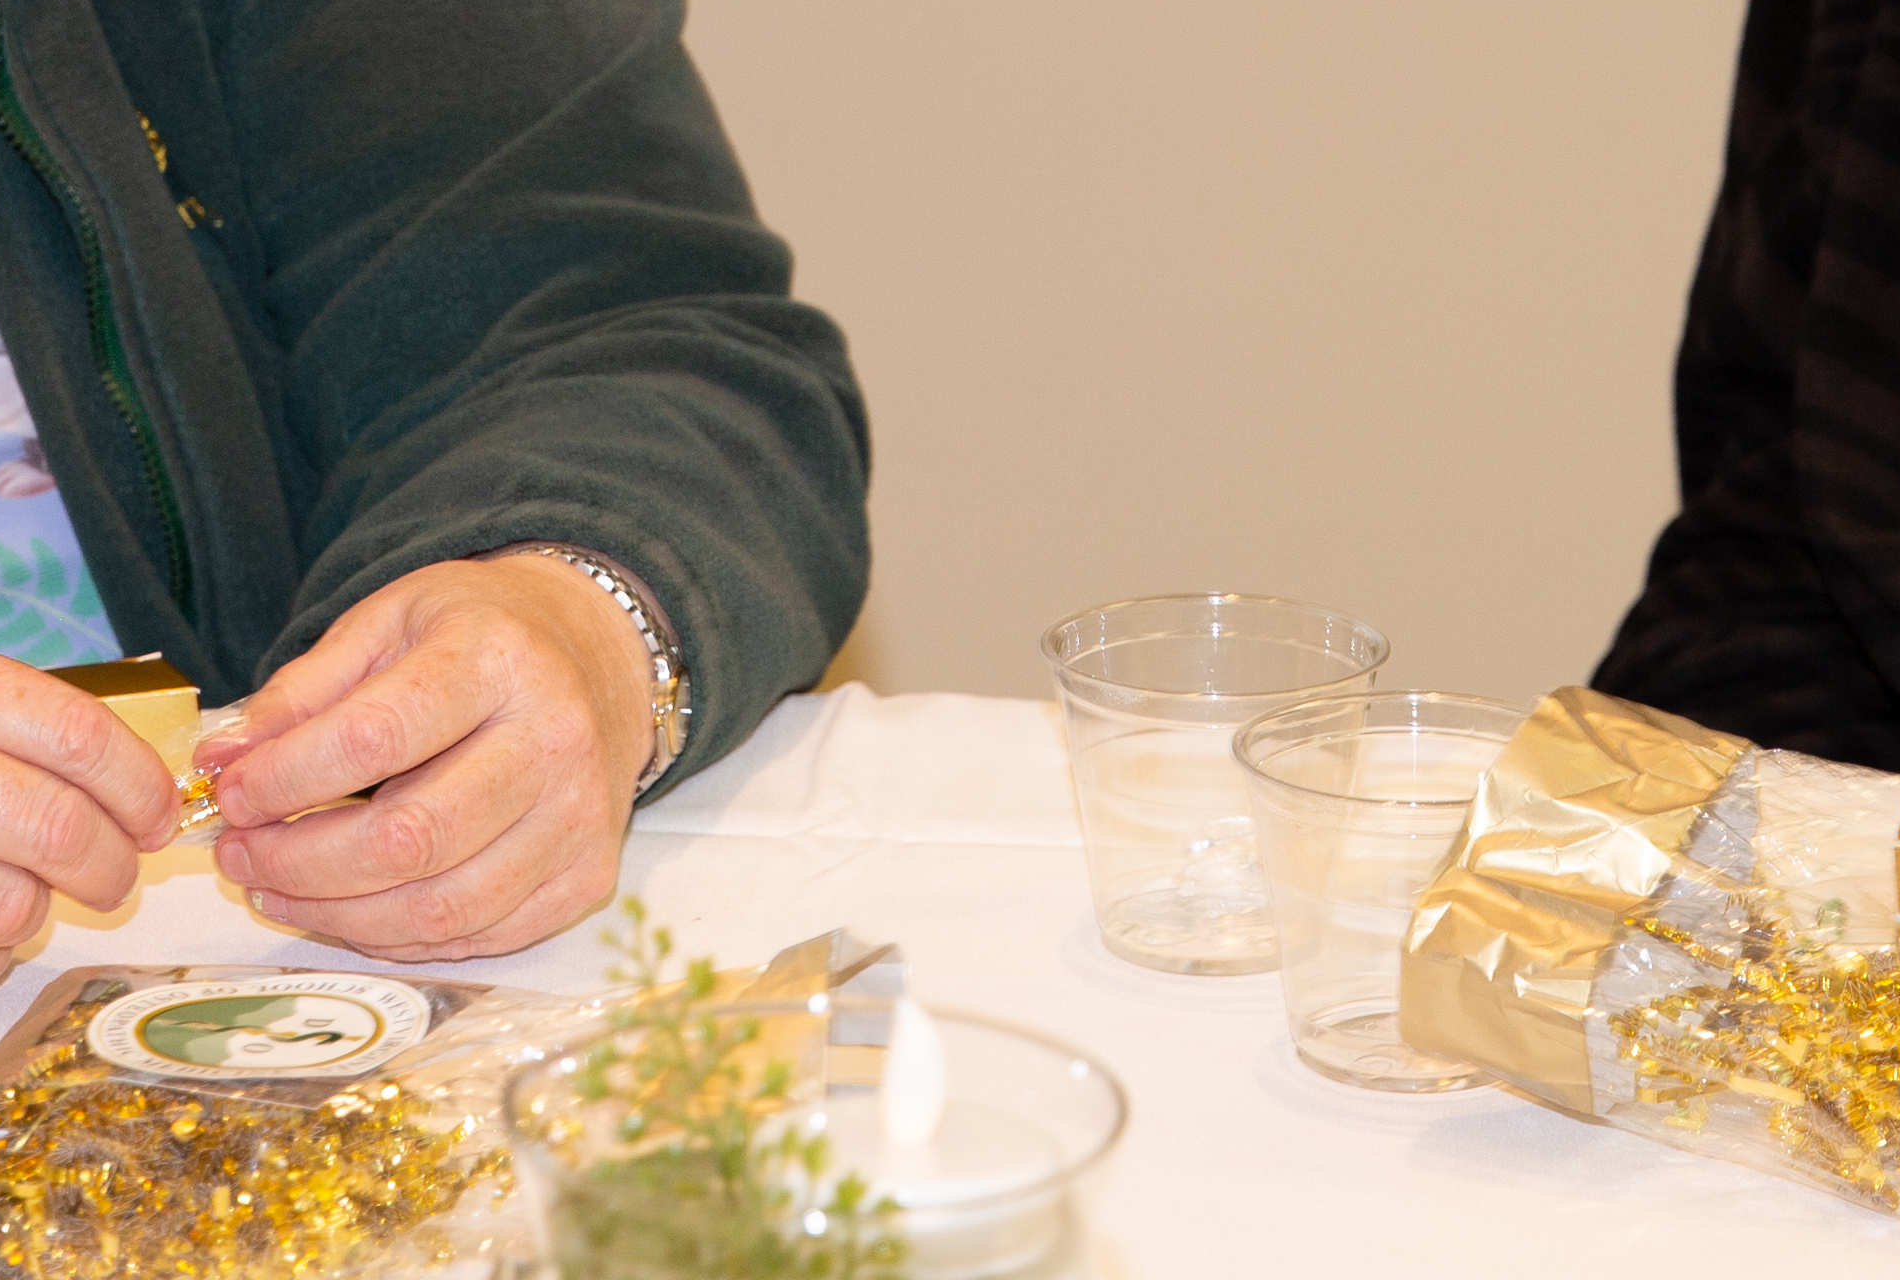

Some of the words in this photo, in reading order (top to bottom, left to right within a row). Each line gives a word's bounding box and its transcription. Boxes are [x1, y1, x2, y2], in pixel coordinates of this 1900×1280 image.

[200, 985, 239, 997] OF
[250, 980, 373, 995] SCHOOL
[377, 991, 415, 1026] WEST
[103, 990, 190, 1059] OSTEOPATHIC
[304, 1017, 337, 1029] D
